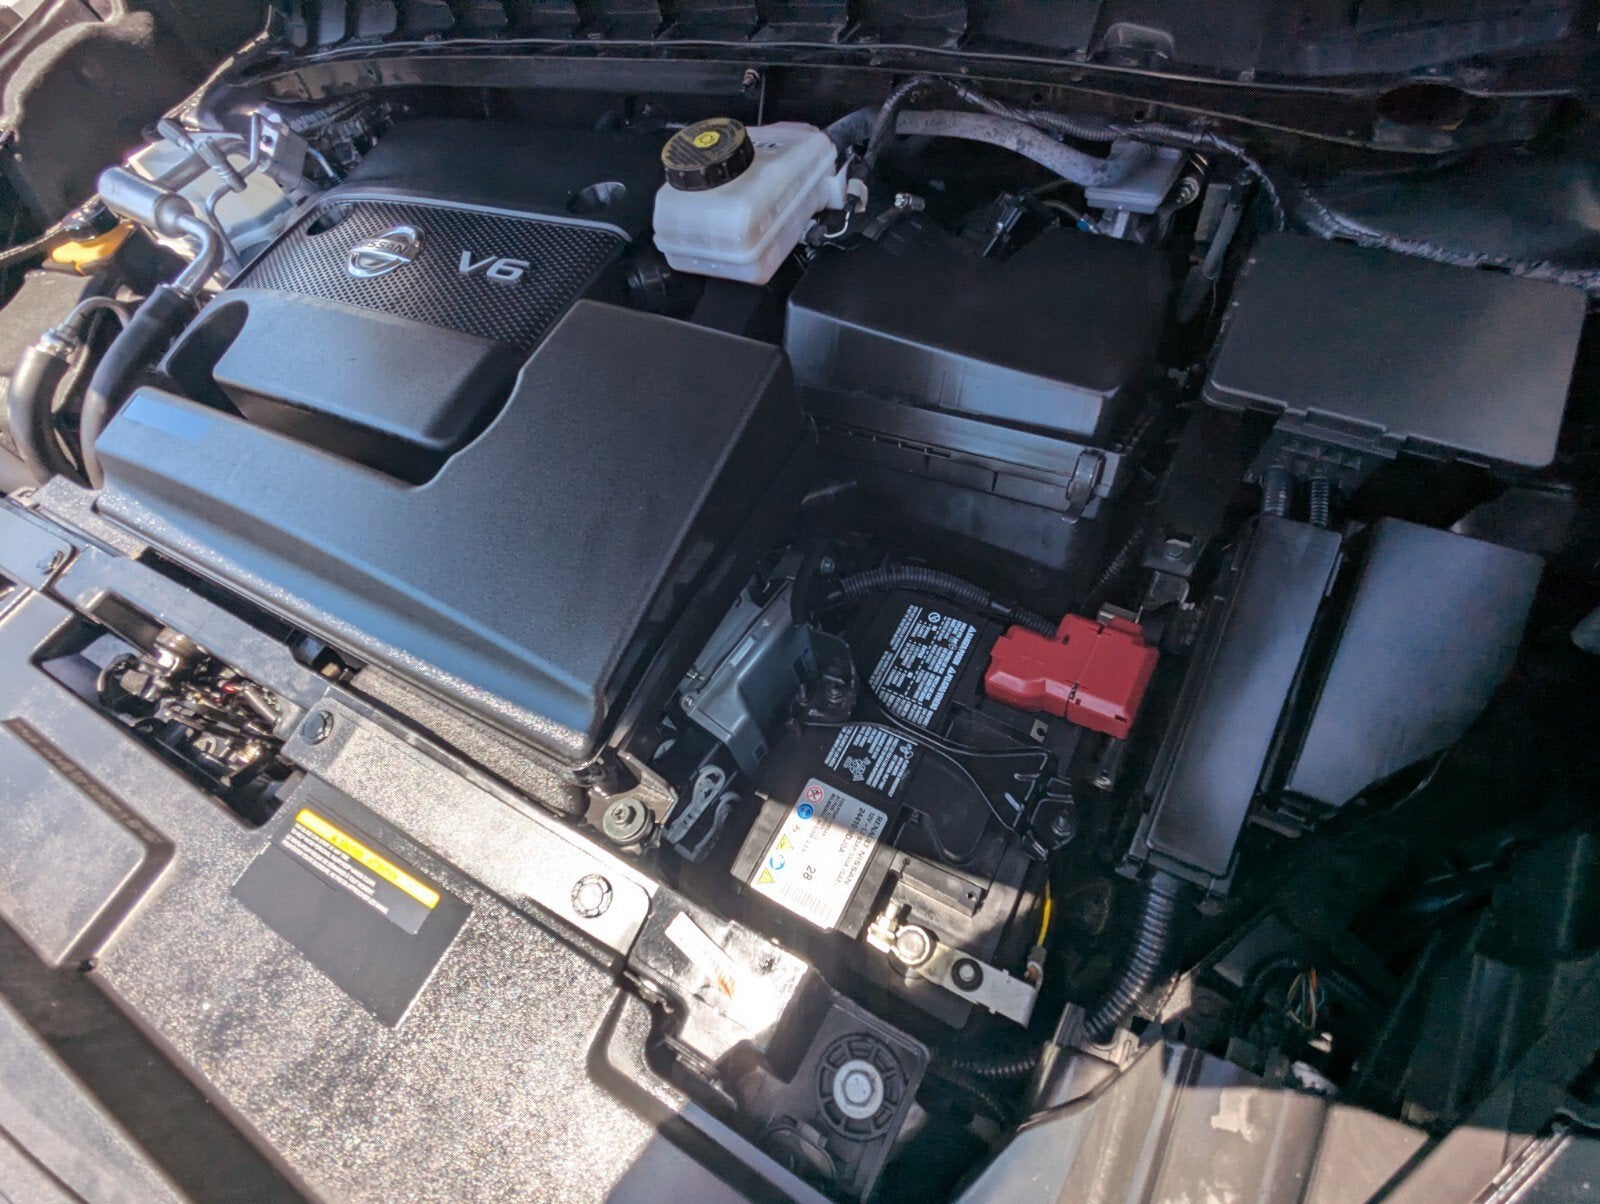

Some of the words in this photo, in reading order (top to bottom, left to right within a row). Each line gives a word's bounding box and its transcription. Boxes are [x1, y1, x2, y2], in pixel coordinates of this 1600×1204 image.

[458, 250, 531, 282] V6
[850, 807, 865, 829] 24410
[864, 815, 883, 848] RENAULT
[803, 865, 816, 881] 28
[843, 850, 865, 885] NISSAN
